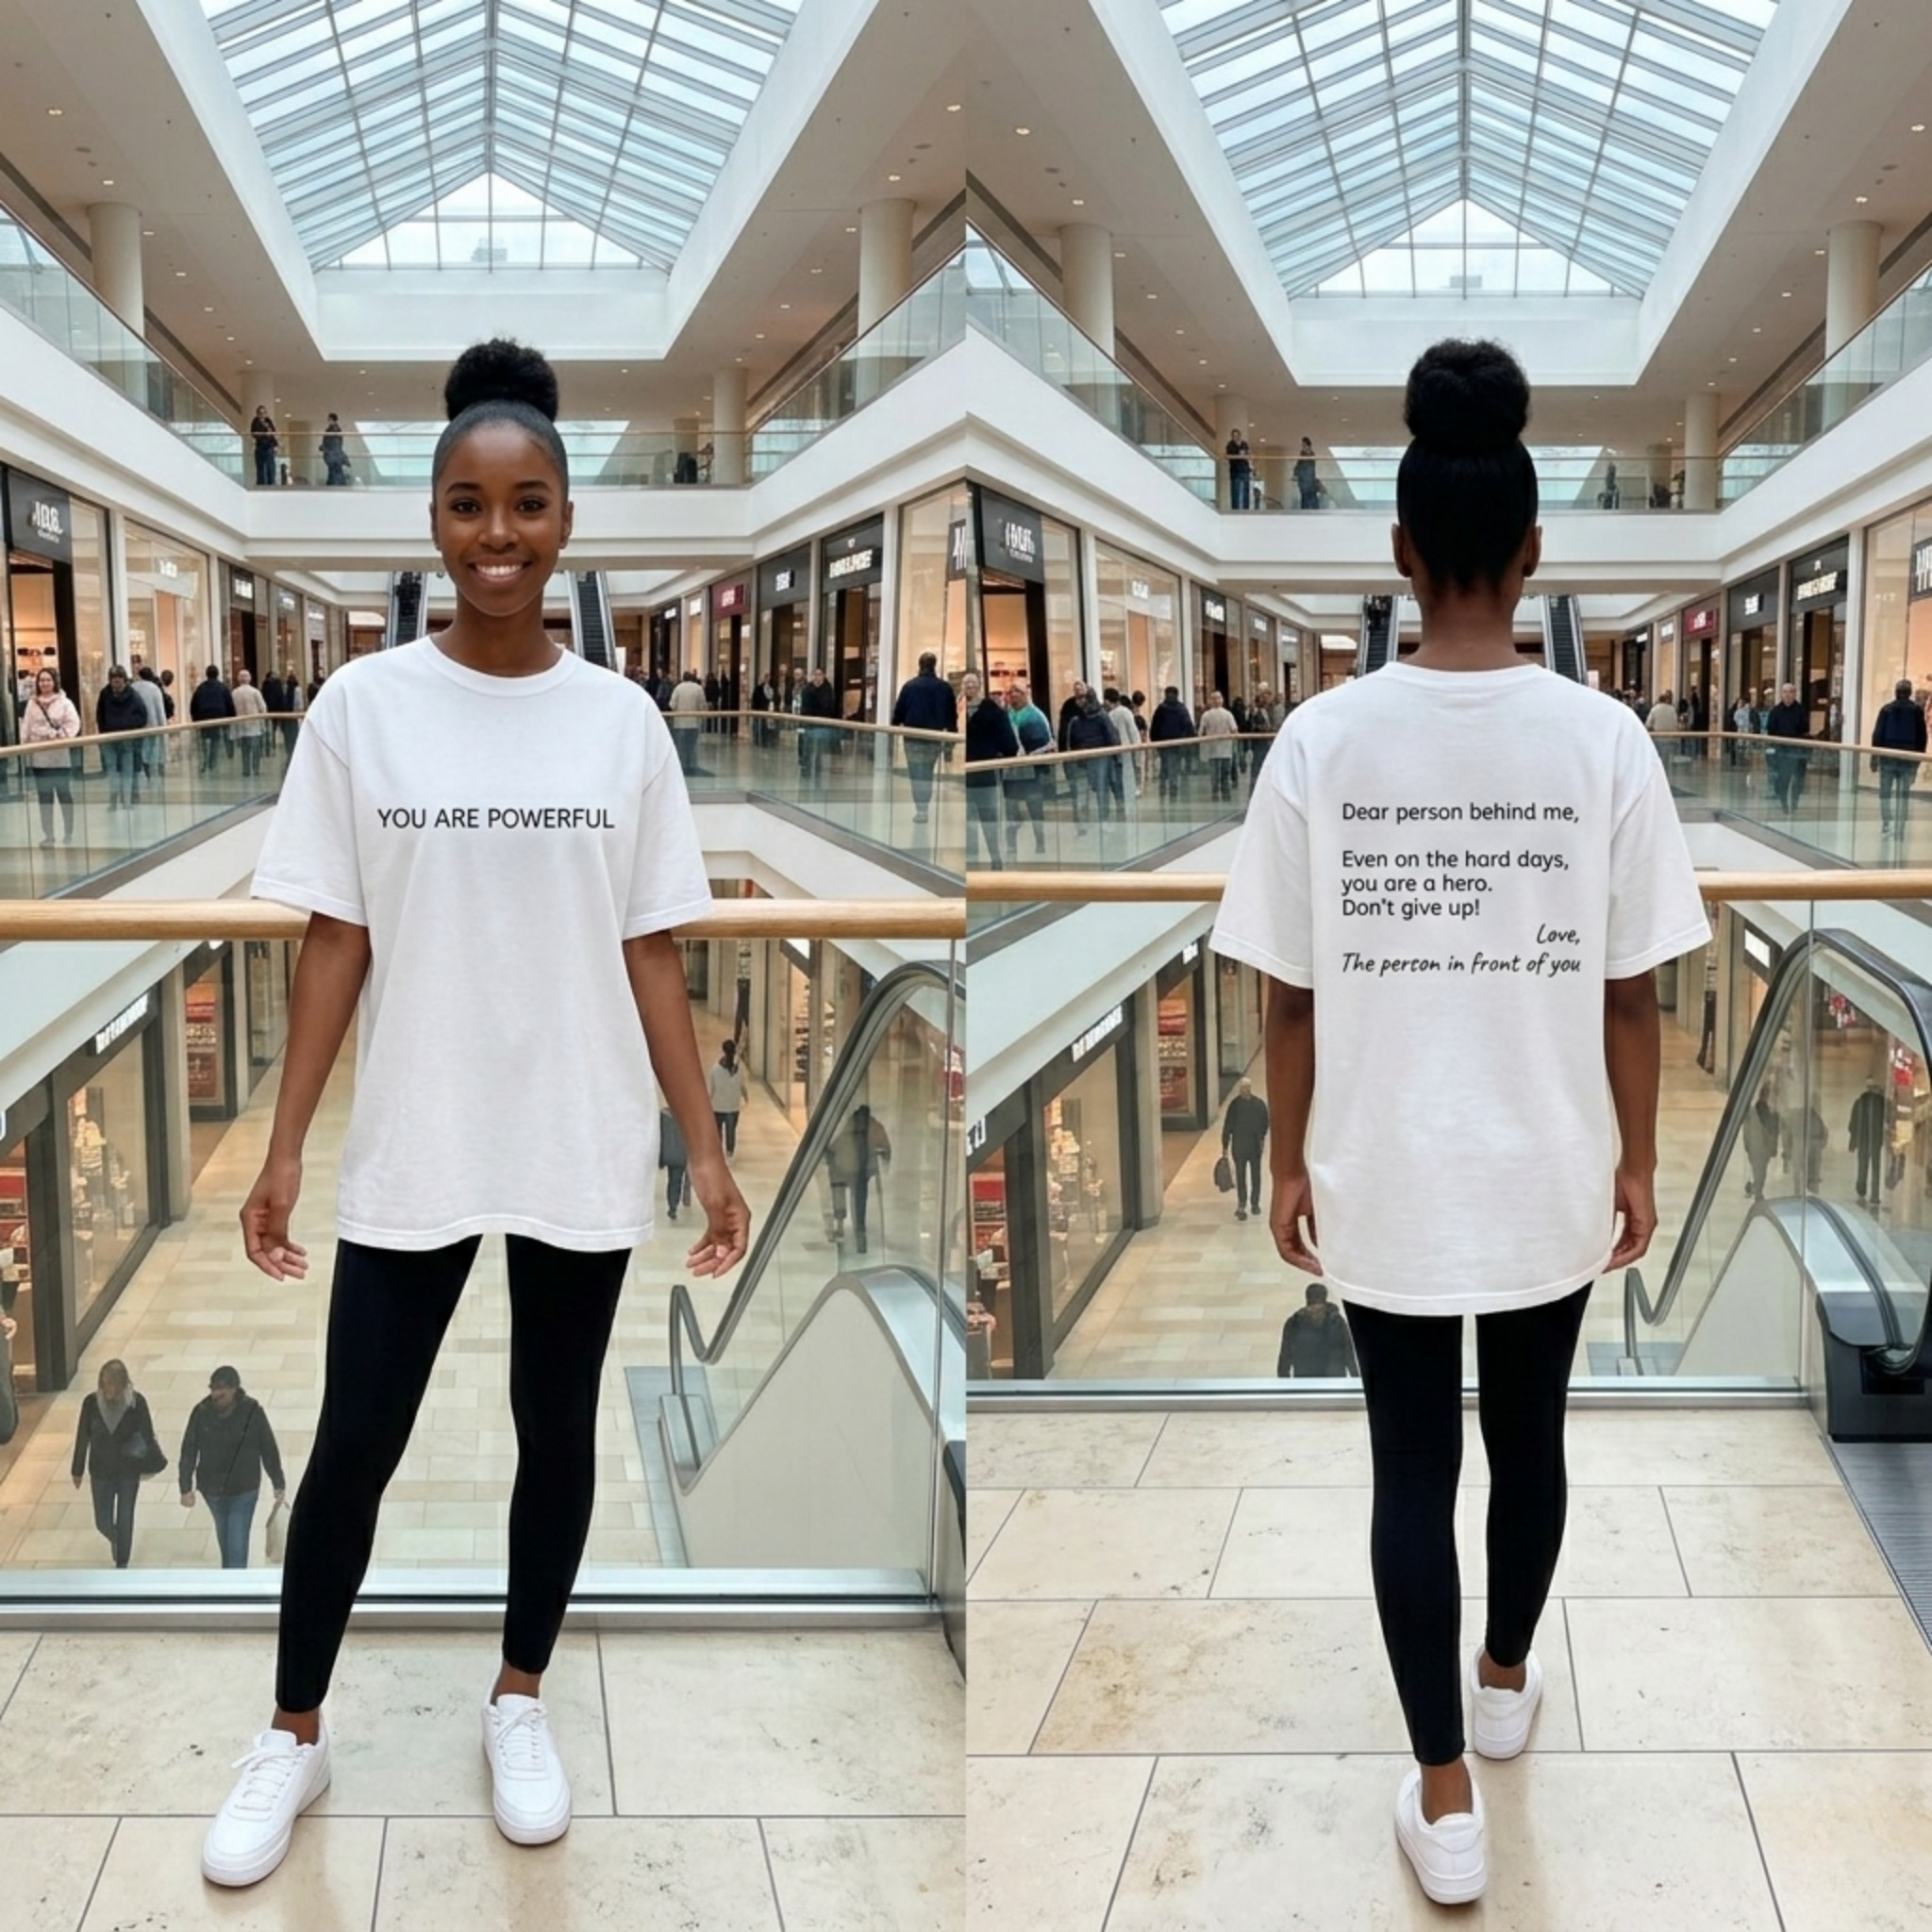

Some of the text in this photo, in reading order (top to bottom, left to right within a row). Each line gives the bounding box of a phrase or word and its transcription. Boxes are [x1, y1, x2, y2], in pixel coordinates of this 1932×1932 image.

[376, 808, 615, 829] YOU ARE POWERFUL
[1342, 801, 1579, 825] Dear person behind me,
[1341, 849, 1569, 874] Even on the hard days,
[1341, 873, 1493, 897] you are a hero.
[1342, 897, 1480, 922] Don't give up!
[1536, 923, 1581, 946] Love,
[1342, 951, 1581, 978] The person in front of you
